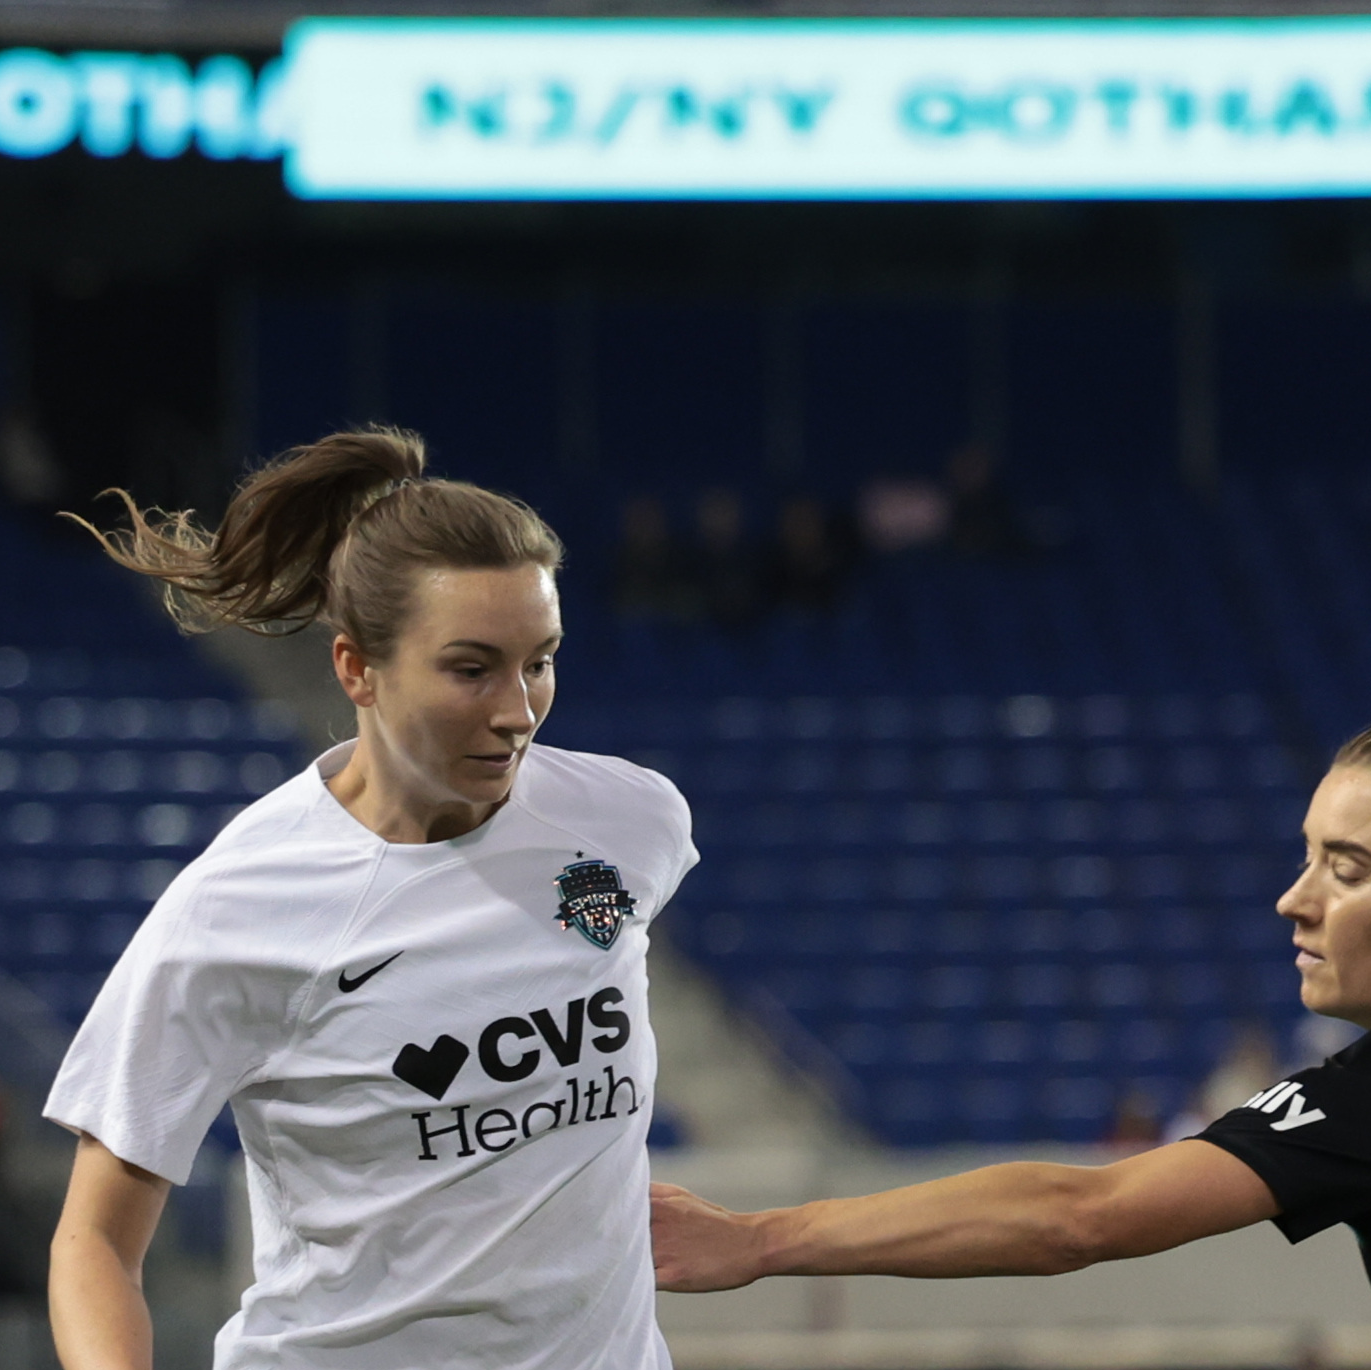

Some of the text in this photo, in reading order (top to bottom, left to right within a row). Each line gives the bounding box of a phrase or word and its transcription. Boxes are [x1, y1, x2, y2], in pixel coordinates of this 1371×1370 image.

[567, 891, 617, 915] SPIRIT
[478, 986, 631, 1083] CVS
[411, 1065, 640, 1161] Health
